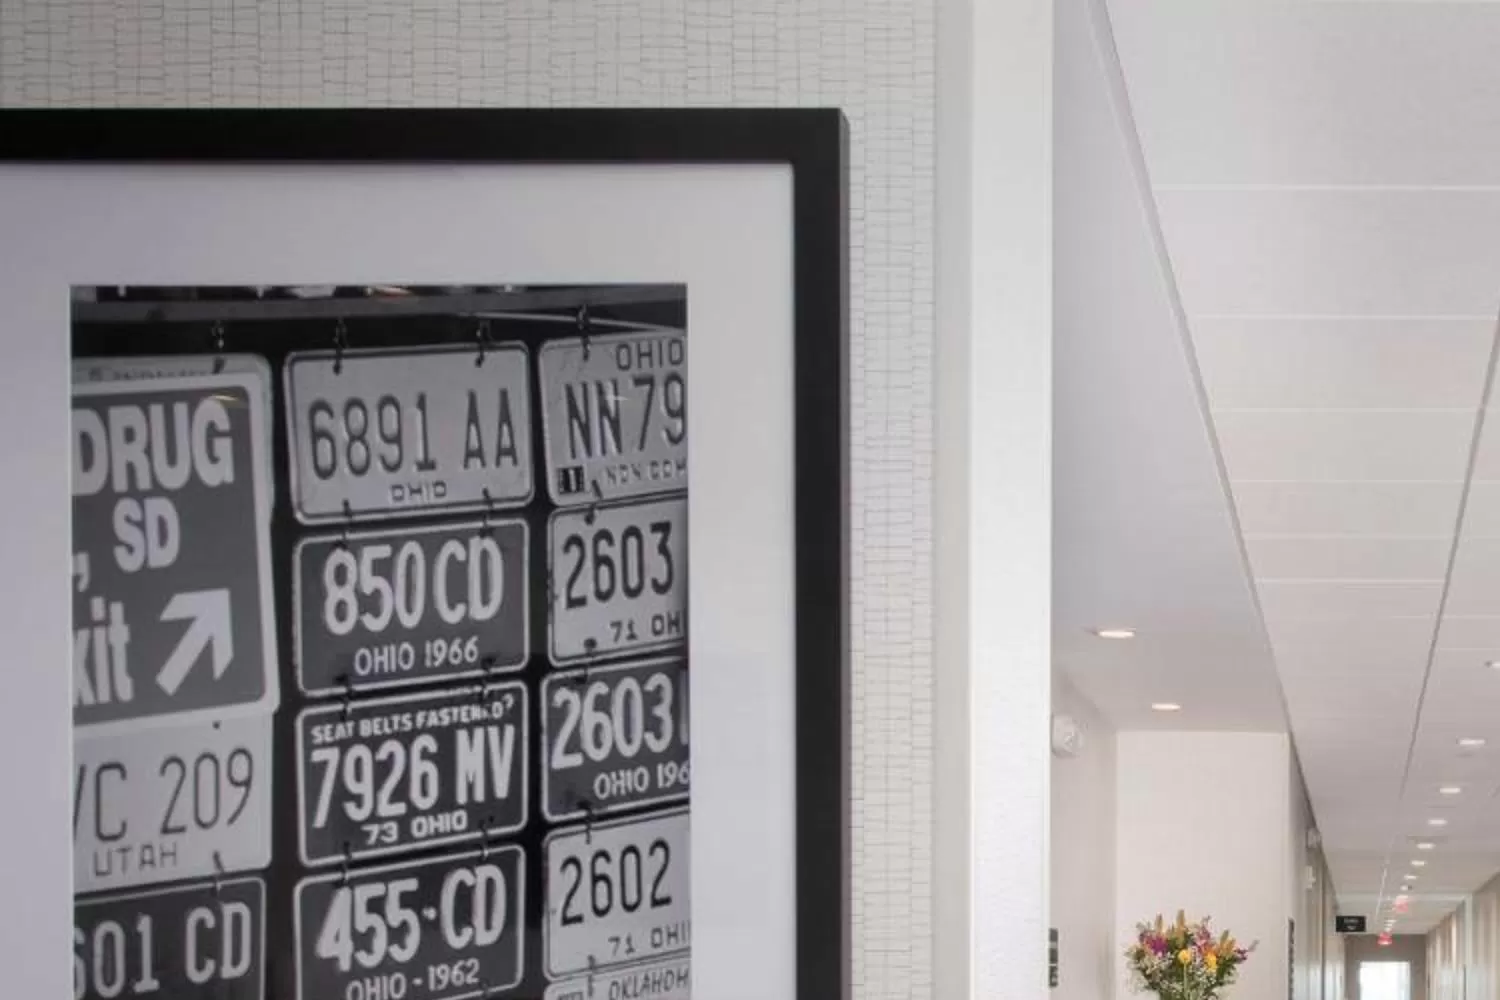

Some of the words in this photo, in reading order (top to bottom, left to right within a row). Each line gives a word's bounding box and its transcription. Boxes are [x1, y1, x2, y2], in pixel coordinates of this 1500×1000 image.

[616, 339, 683, 370] OHIO
[72, 396, 234, 494] DRUG
[309, 392, 436, 480] 6891
[463, 389, 517, 469] AA
[391, 480, 447, 500] OHIO
[113, 497, 180, 572] SD
[563, 520, 674, 609] 2603
[324, 540, 425, 635] 850
[434, 536, 503, 624] CD
[354, 642, 415, 675] OHIO
[424, 635, 479, 667] 1966
[610, 618, 638, 642] 71
[311, 721, 354, 744] SEAT
[359, 713, 412, 737] BELTS
[552, 672, 673, 769] 2603
[159, 746, 253, 834] 209
[311, 734, 439, 828] 7926
[456, 723, 515, 804] MV
[593, 766, 649, 799] OHIO
[94, 841, 177, 876] UTAH
[361, 820, 398, 845] 73
[411, 809, 467, 838] OHIO
[315, 877, 420, 972] 455
[441, 864, 506, 949] CD
[560, 838, 672, 927] 2602
[186, 902, 251, 983] CD
[428, 957, 480, 991] 1962
[608, 932, 636, 956] 71
[651, 919, 690, 948] OHI
